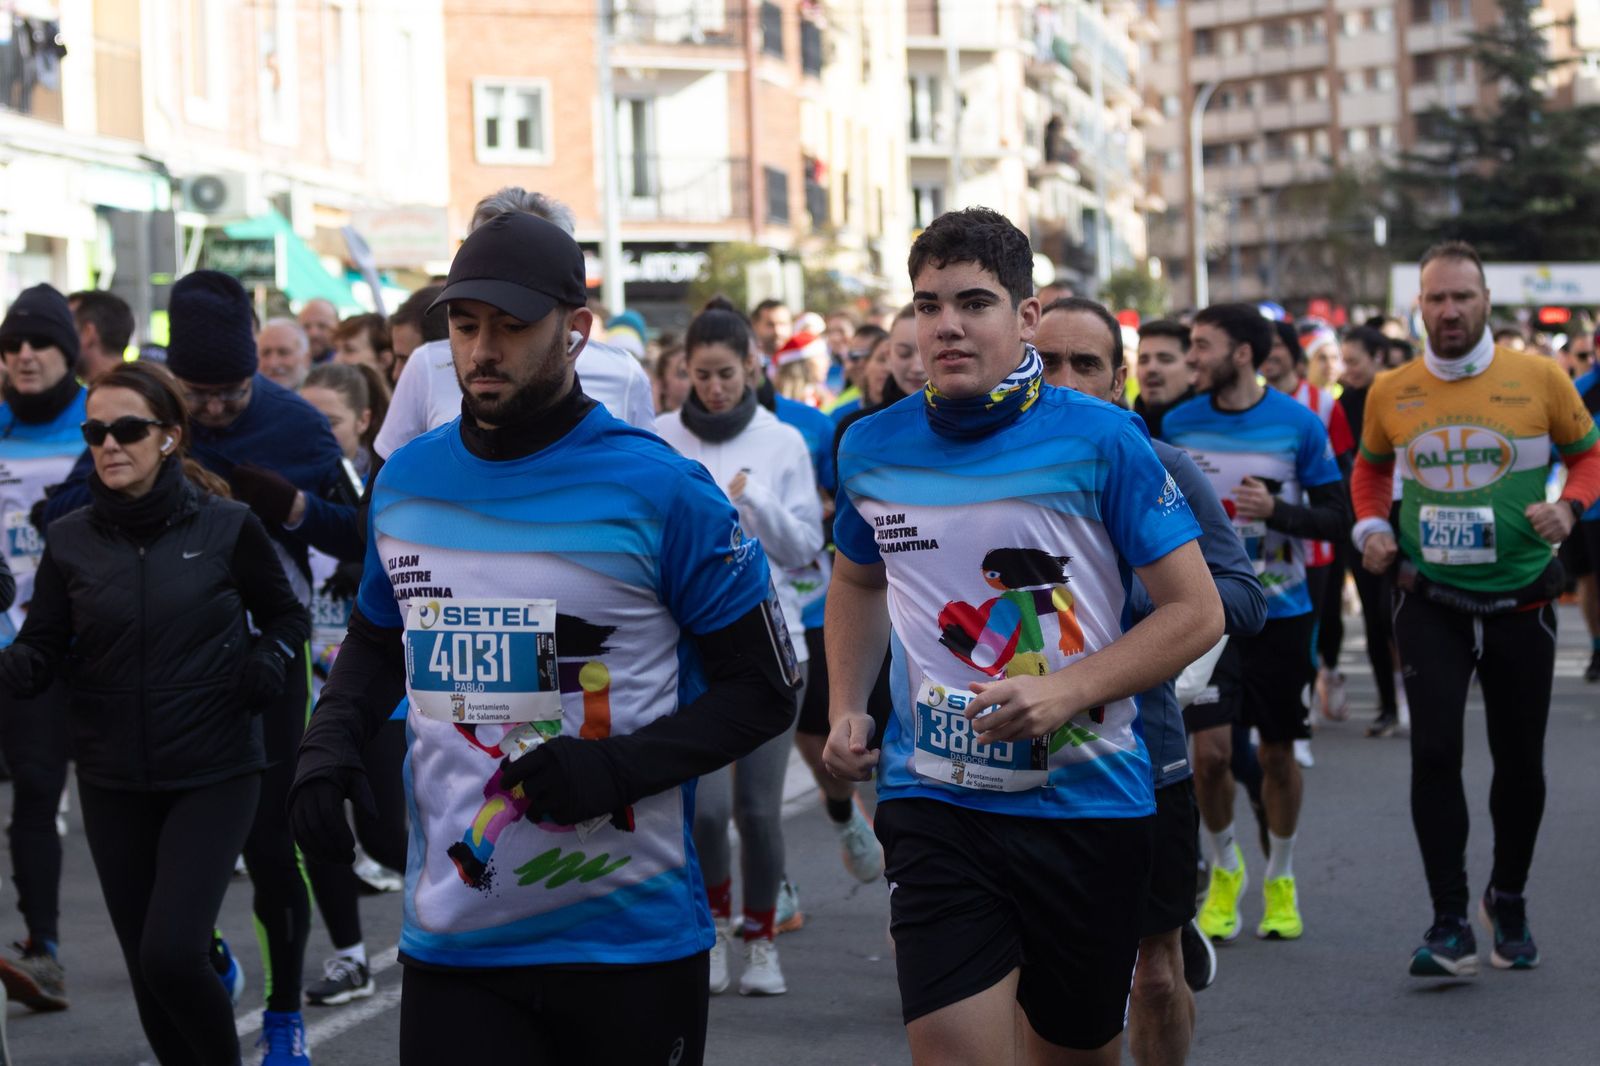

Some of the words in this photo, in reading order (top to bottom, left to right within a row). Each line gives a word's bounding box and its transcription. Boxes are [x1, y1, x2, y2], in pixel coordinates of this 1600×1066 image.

[1415, 447, 1504, 469] ALCER
[885, 513, 906, 526] SAN
[1437, 510, 1486, 522] SETEL
[1428, 522, 1475, 547] 2575
[398, 554, 419, 568] SAN
[443, 606, 539, 627] SETEL
[429, 632, 511, 683] 4031
[454, 682, 485, 693] PABLO
[467, 702, 510, 713] Ayuntamiento
[467, 712, 475, 721] de
[476, 712, 510, 721] Salamanca
[951, 752, 988, 766] DABOCRE
[966, 771, 1004, 783] Ayuntamiento
[974, 780, 1004, 790] Salamanca
